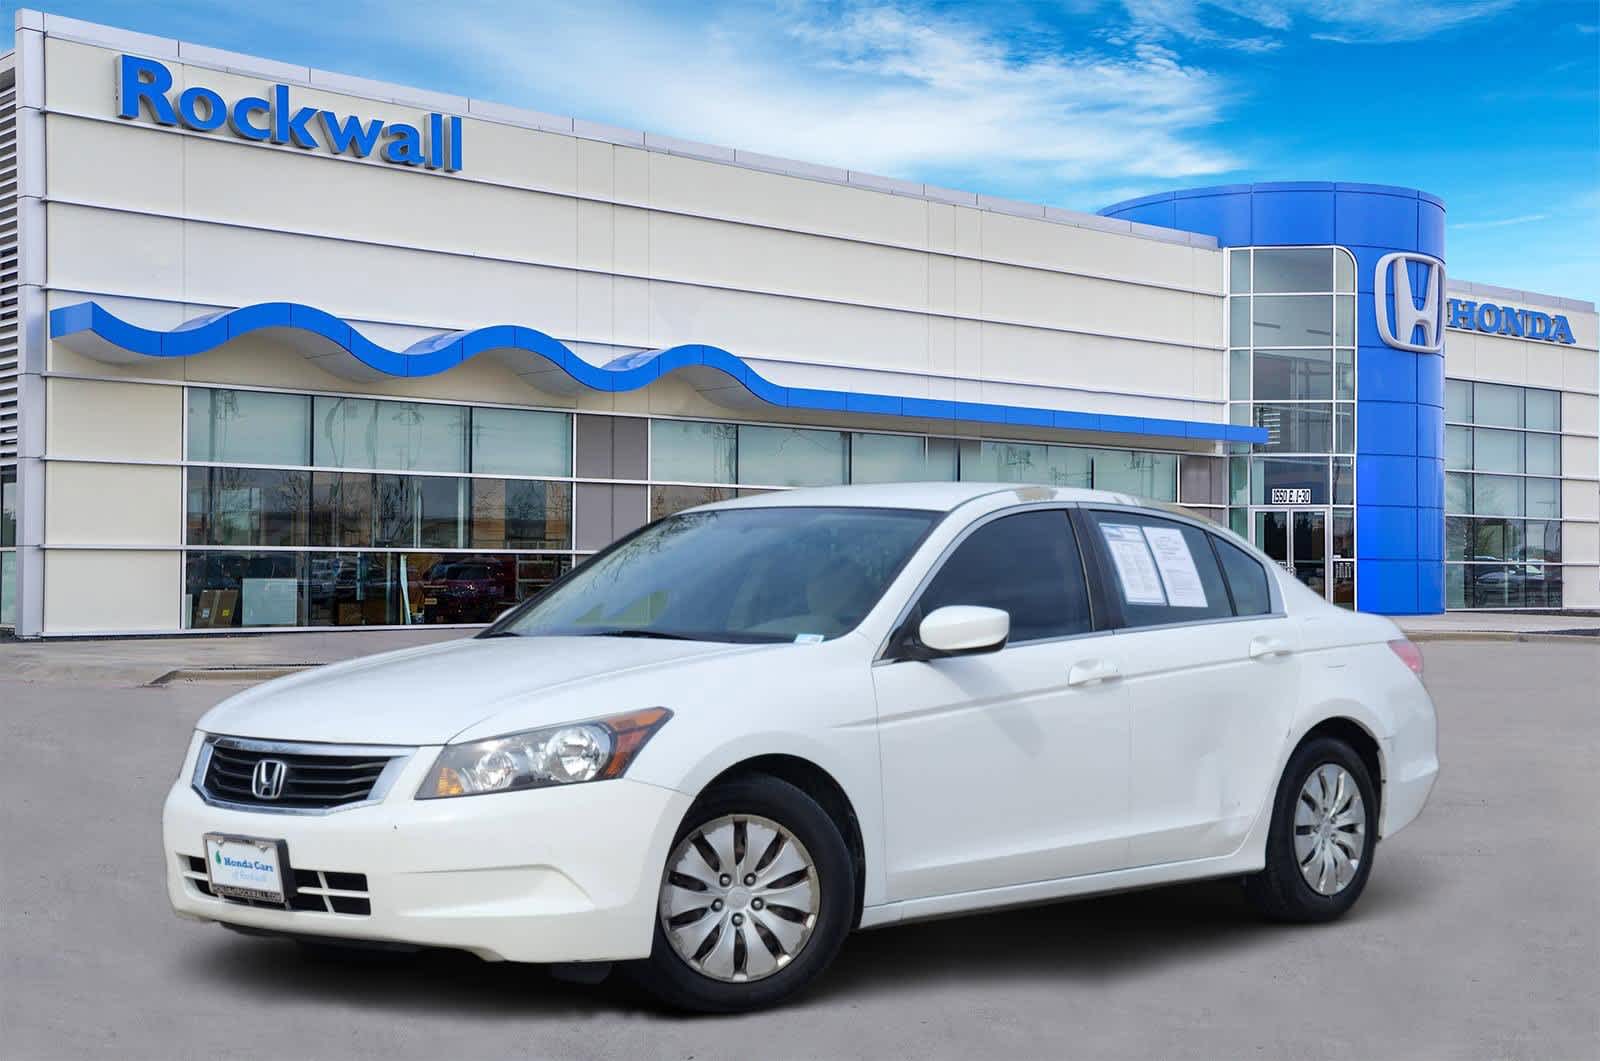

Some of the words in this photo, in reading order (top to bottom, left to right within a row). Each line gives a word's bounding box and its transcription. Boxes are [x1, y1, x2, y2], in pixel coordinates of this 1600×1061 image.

[117, 53, 463, 172] Rockwall
[1447, 298, 1577, 345] HONDA
[1273, 489, 1287, 502] 1550
[224, 857, 253, 869] Honda
